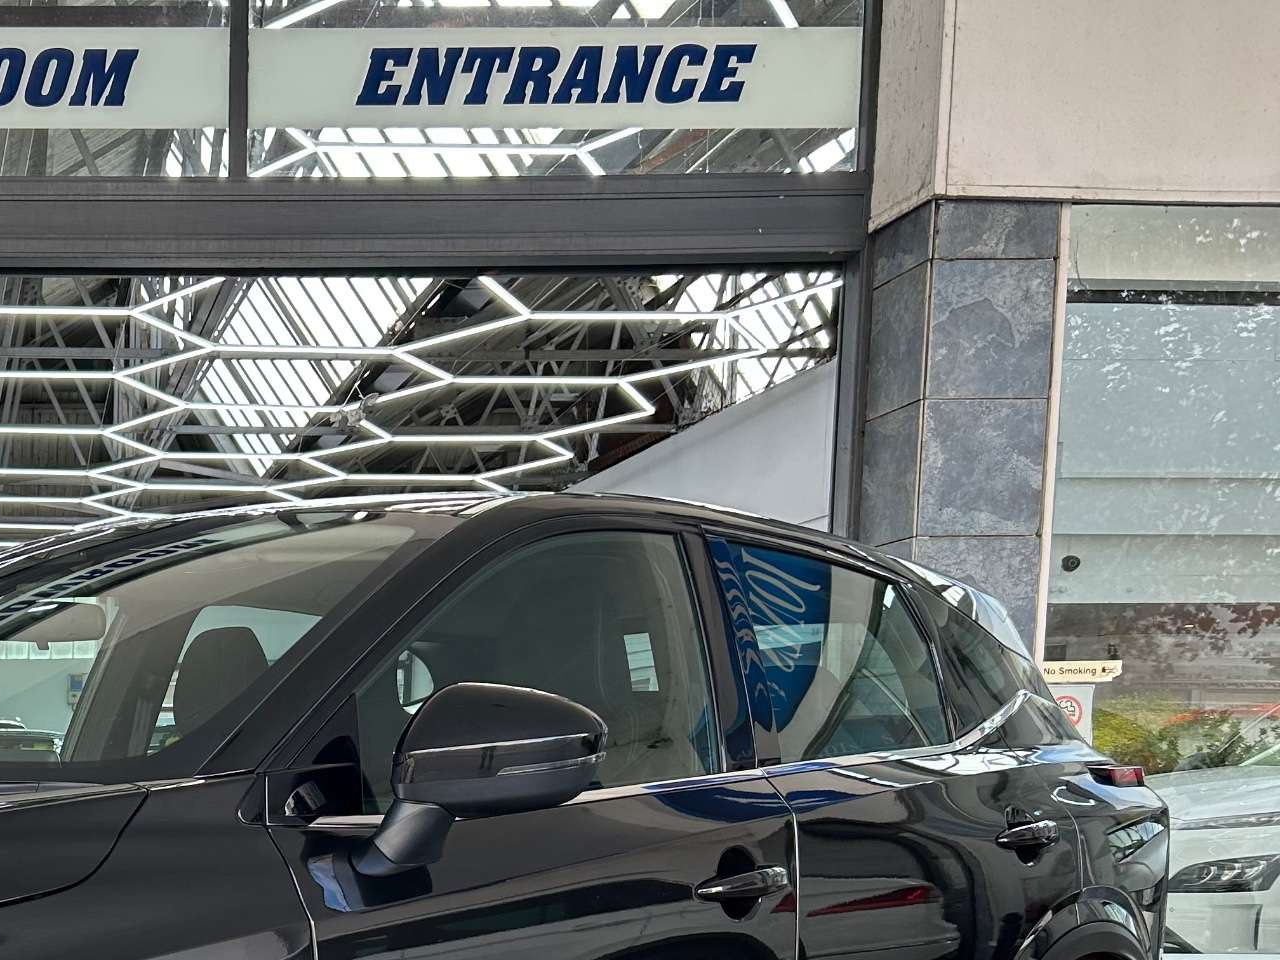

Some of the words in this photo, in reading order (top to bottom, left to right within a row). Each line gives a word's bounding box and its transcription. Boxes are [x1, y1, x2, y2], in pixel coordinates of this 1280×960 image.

[356, 44, 757, 106] ENTRANCE
[1043, 667, 1056, 675] No
[1058, 667, 1097, 676] Smoking
